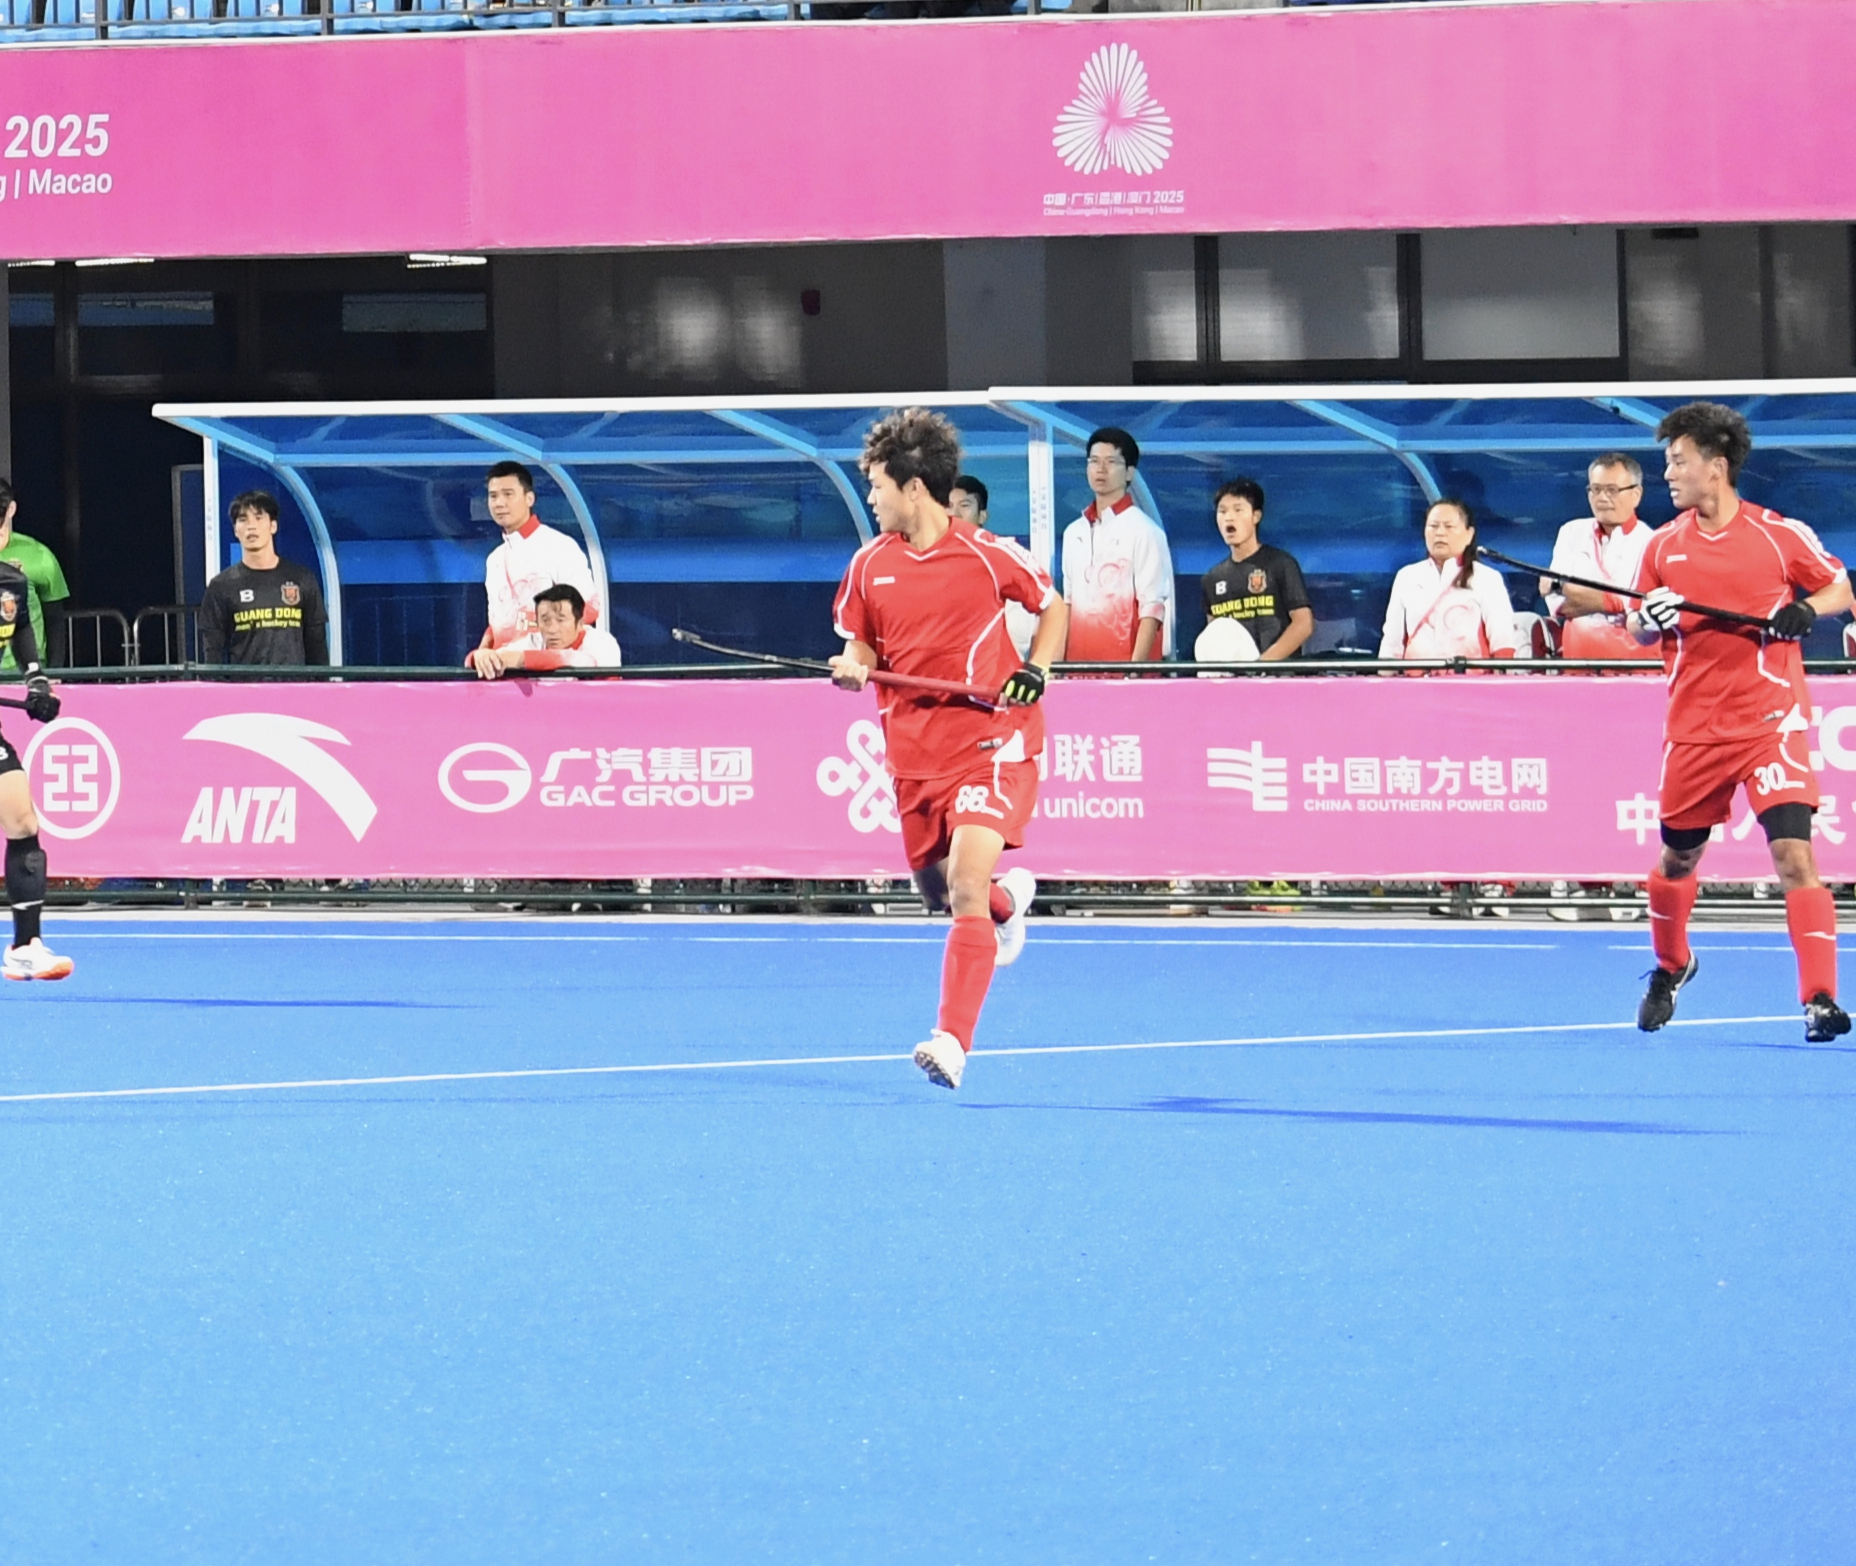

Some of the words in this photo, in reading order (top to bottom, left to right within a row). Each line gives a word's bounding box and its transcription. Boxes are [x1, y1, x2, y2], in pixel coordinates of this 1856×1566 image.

[4, 113, 111, 160] 2025
[28, 168, 113, 196] Macao
[1153, 190, 1185, 204] 2025
[233, 608, 272, 623] GUANG
[1243, 595, 1274, 608] DONG
[540, 747, 752, 783] 广汽集团
[1303, 756, 1549, 796] 中国南方电网
[1754, 762, 1786, 796] 30
[540, 784, 615, 807] GAC
[621, 784, 754, 807] GROUP
[1303, 799, 1352, 813] CHINA
[1357, 799, 1443, 813] SOUTHERN
[1447, 799, 1505, 812] POWER
[1509, 799, 1549, 812] GRID
[181, 787, 296, 843] ANTA
